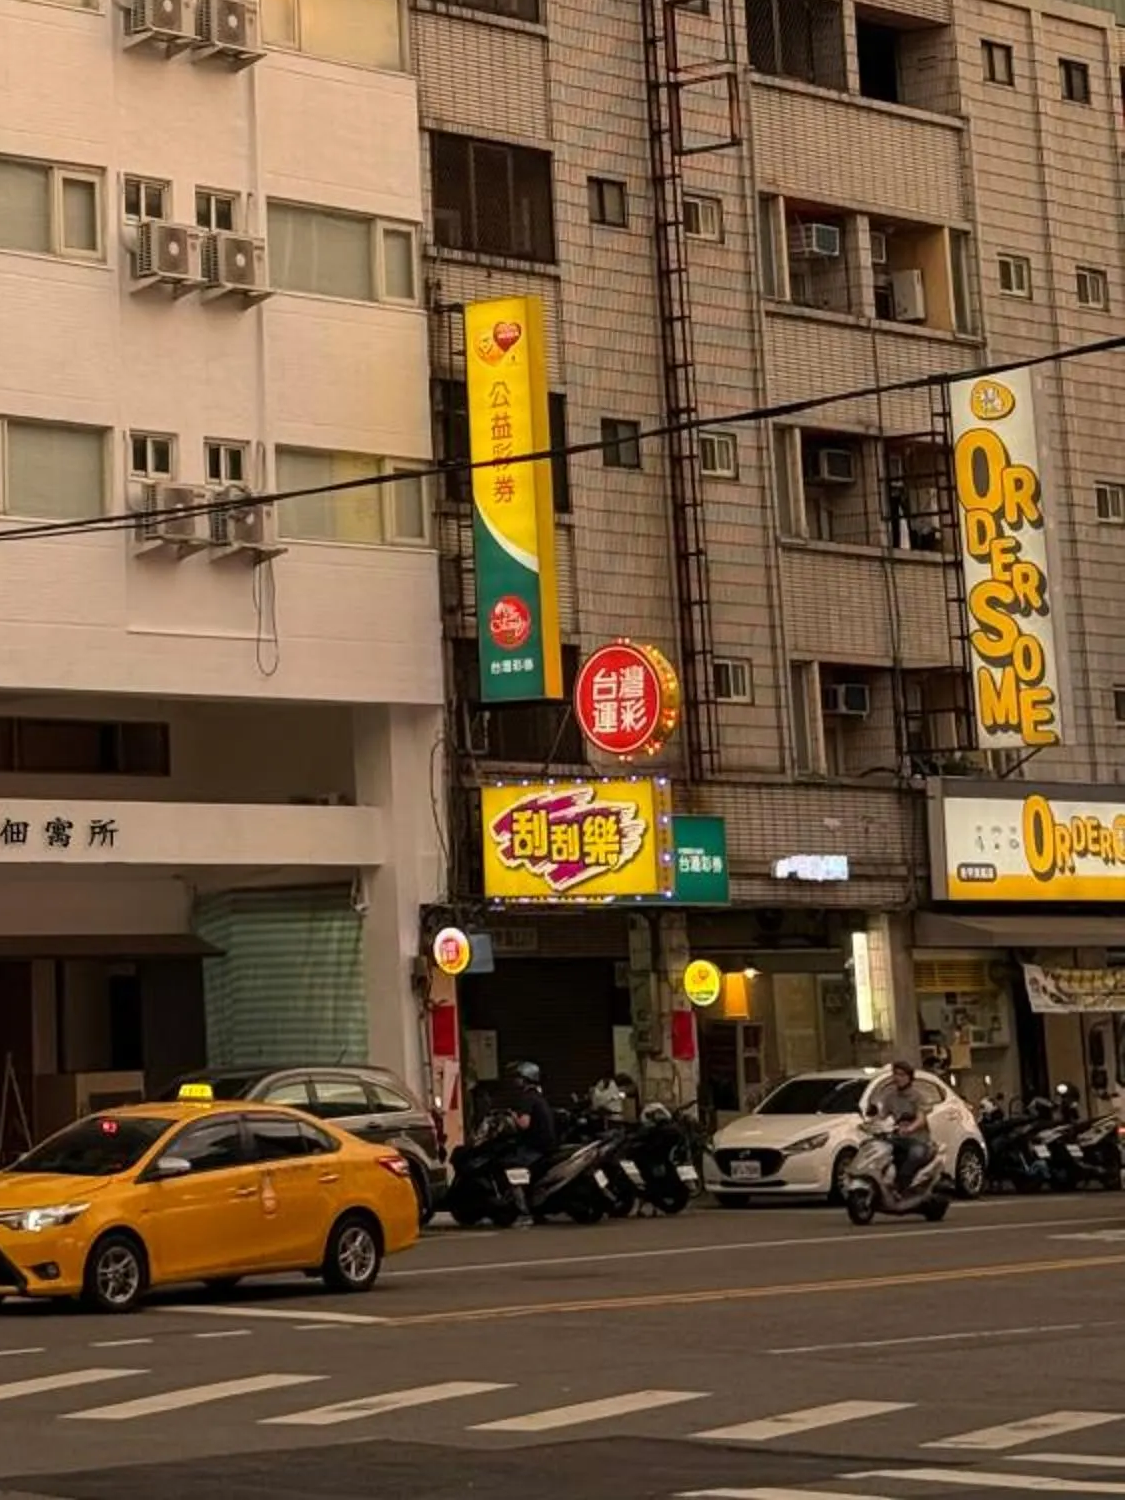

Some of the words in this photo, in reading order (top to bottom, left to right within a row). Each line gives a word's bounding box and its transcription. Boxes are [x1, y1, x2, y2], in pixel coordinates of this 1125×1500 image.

[488, 381, 516, 504] 公益彩券
[592, 665, 644, 700] 台灣
[592, 701, 648, 733] 運彩
[512, 810, 621, 868] 刮刮樂
